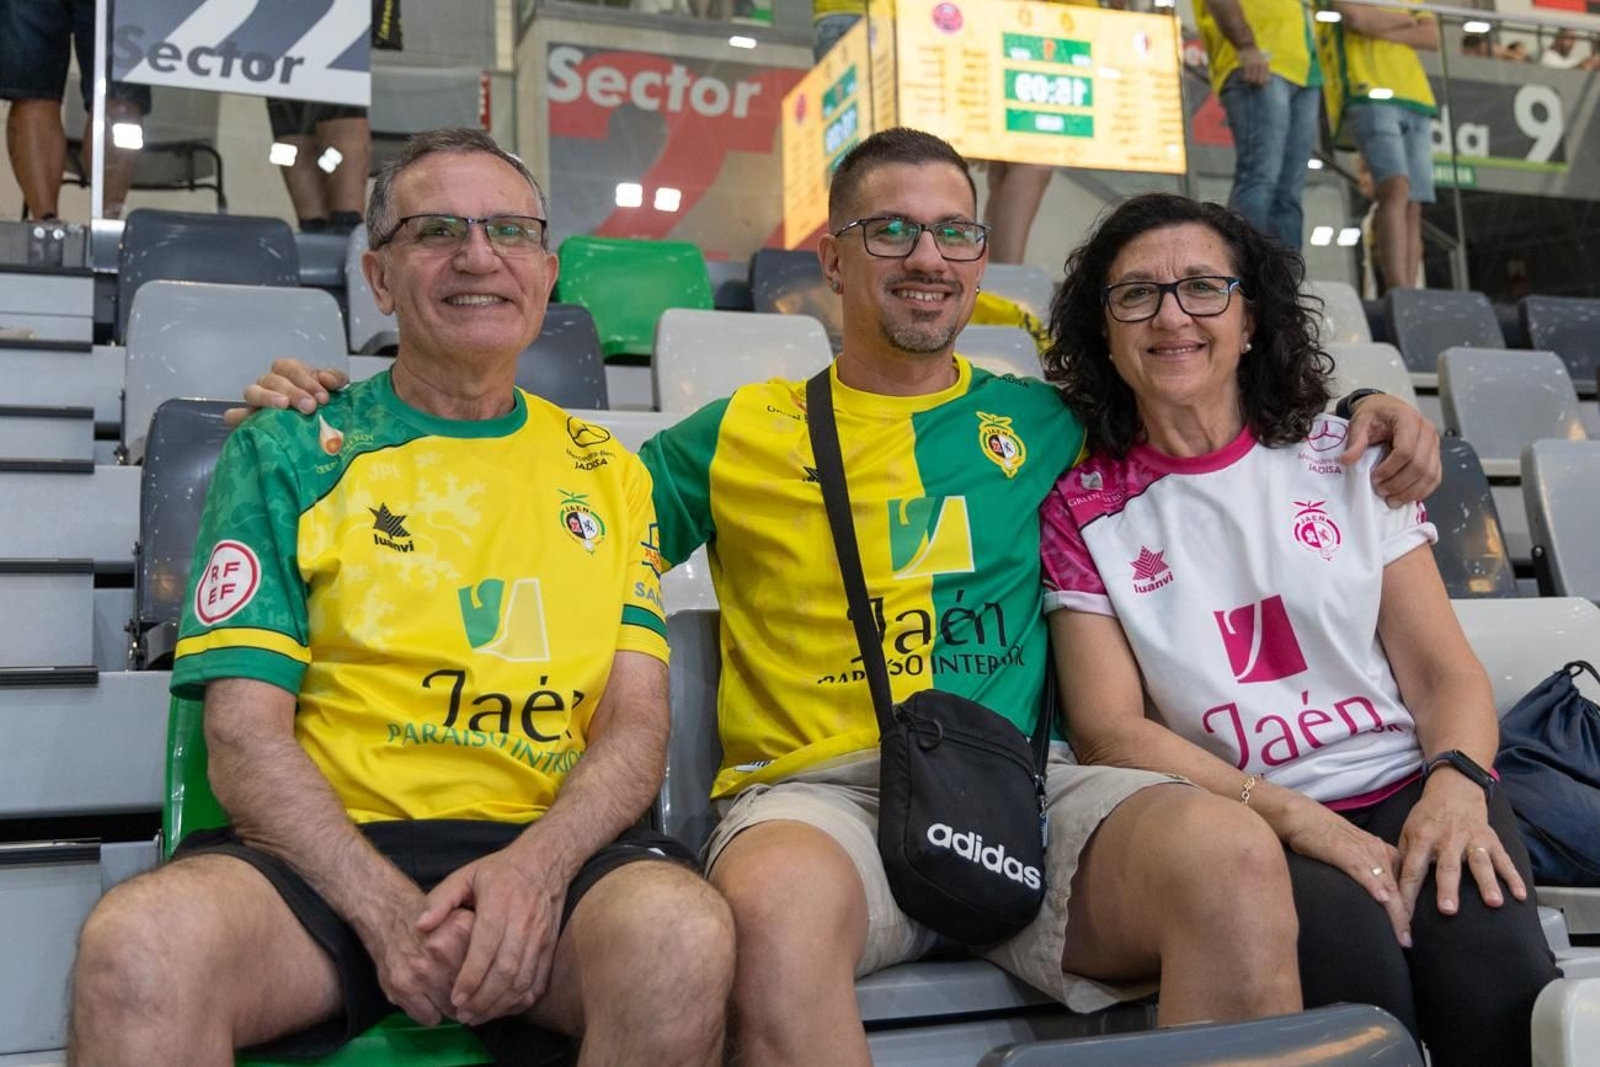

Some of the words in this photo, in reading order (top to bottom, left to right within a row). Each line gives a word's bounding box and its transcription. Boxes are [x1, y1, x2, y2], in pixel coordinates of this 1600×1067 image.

[114, 24, 305, 85] Sector
[547, 46, 762, 119] Sector
[1514, 83, 1564, 163] 9
[1300, 515, 1325, 524] JAEN
[1133, 571, 1174, 595] luanvi
[1202, 691, 1384, 771] Jaén
[926, 822, 1042, 890] adidas
